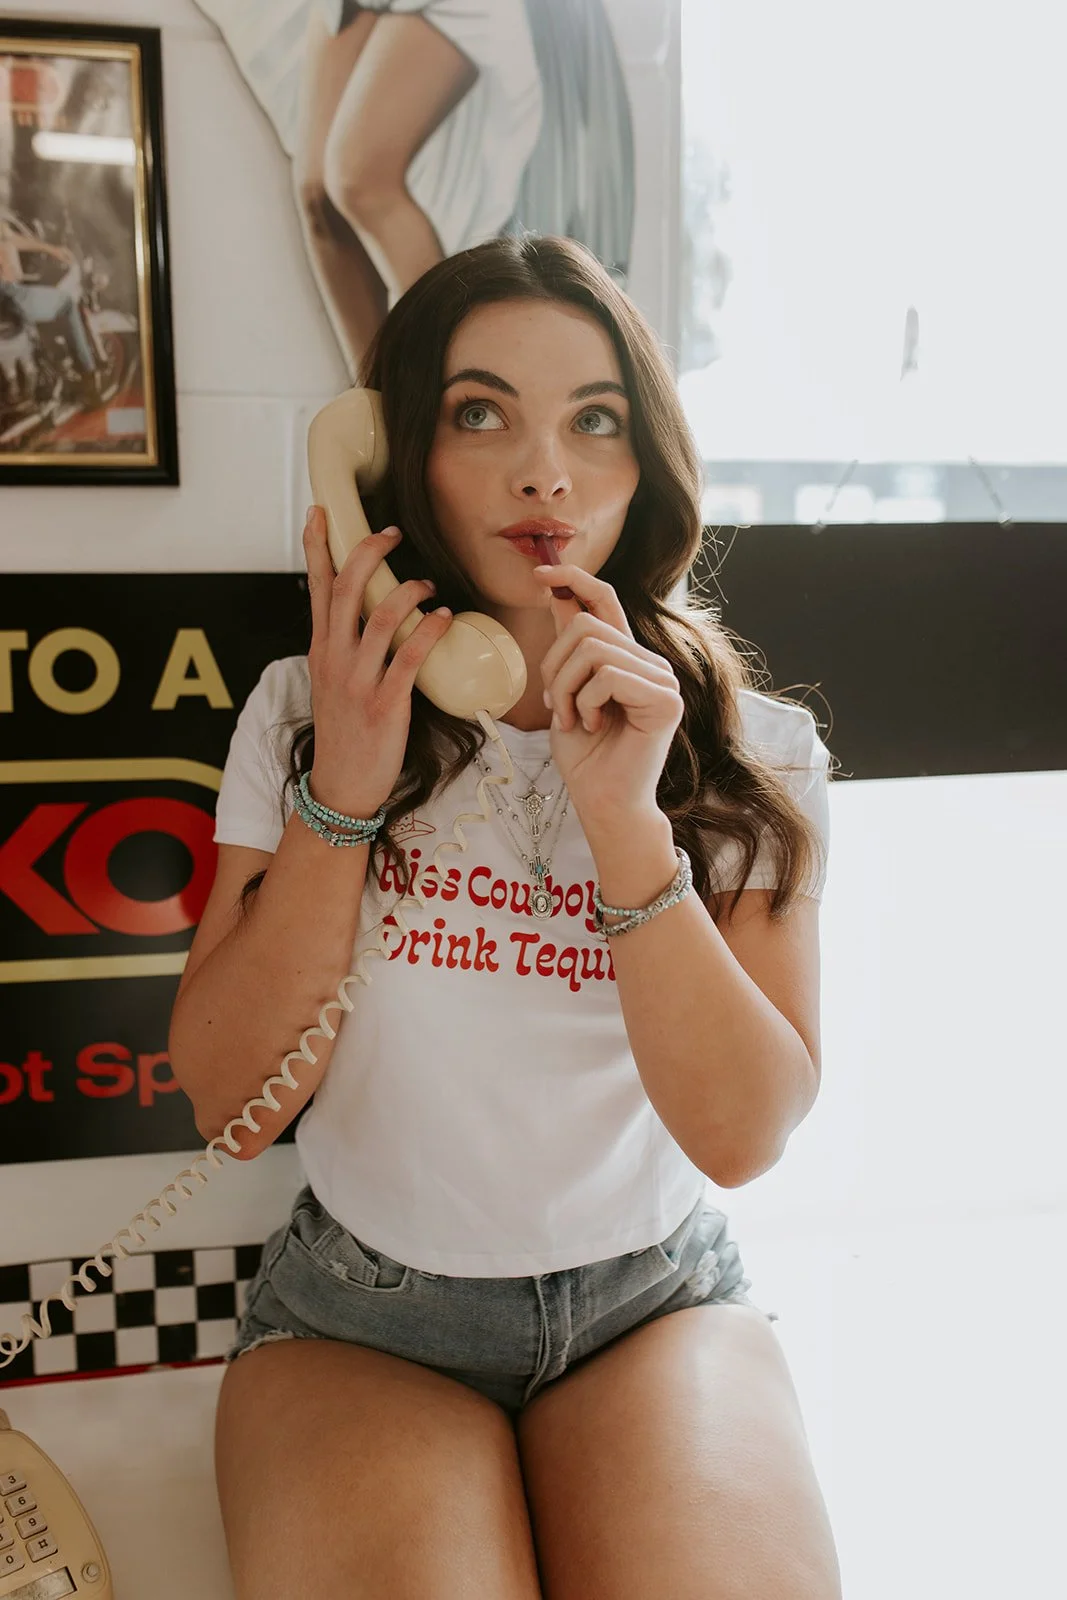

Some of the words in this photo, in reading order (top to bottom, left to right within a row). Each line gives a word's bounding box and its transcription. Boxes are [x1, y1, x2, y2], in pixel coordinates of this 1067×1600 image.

[0, 626, 121, 715] TO
[151, 628, 234, 710] A
[379, 848, 462, 902] Kiss
[382, 915, 500, 973] Drink
[8, 1475, 17, 1484] 3
[18, 1496, 26, 1505] 6
[28, 1517, 37, 1527] 9
